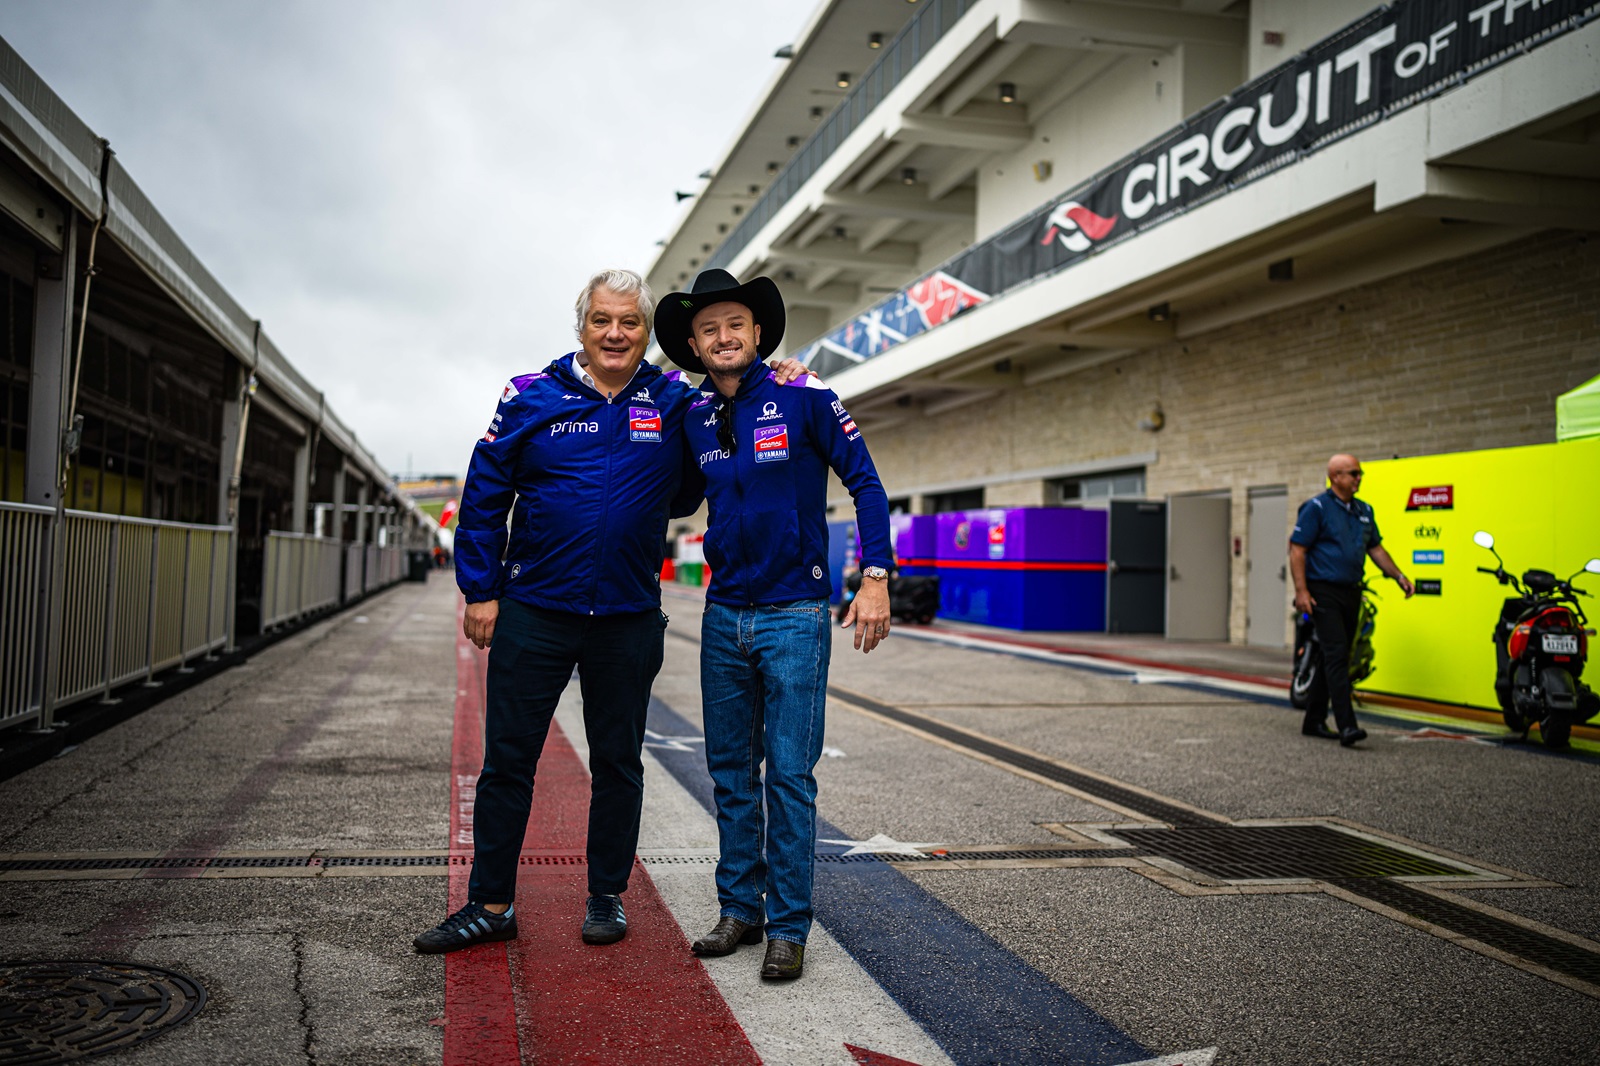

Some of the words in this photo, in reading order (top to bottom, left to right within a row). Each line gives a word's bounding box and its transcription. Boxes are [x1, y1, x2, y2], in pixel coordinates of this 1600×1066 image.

[1122, 24, 1396, 220] CIRCUIT
[1394, 21, 1457, 79] OF
[1468, 0, 1553, 37] TH
[635, 409, 653, 417] prima
[756, 412, 784, 422] PRAMAC
[550, 421, 599, 437] prima
[760, 427, 780, 437] prima
[699, 448, 730, 469] prima
[763, 449, 787, 458] YAMAHA
[1414, 522, 1442, 541] ebay
